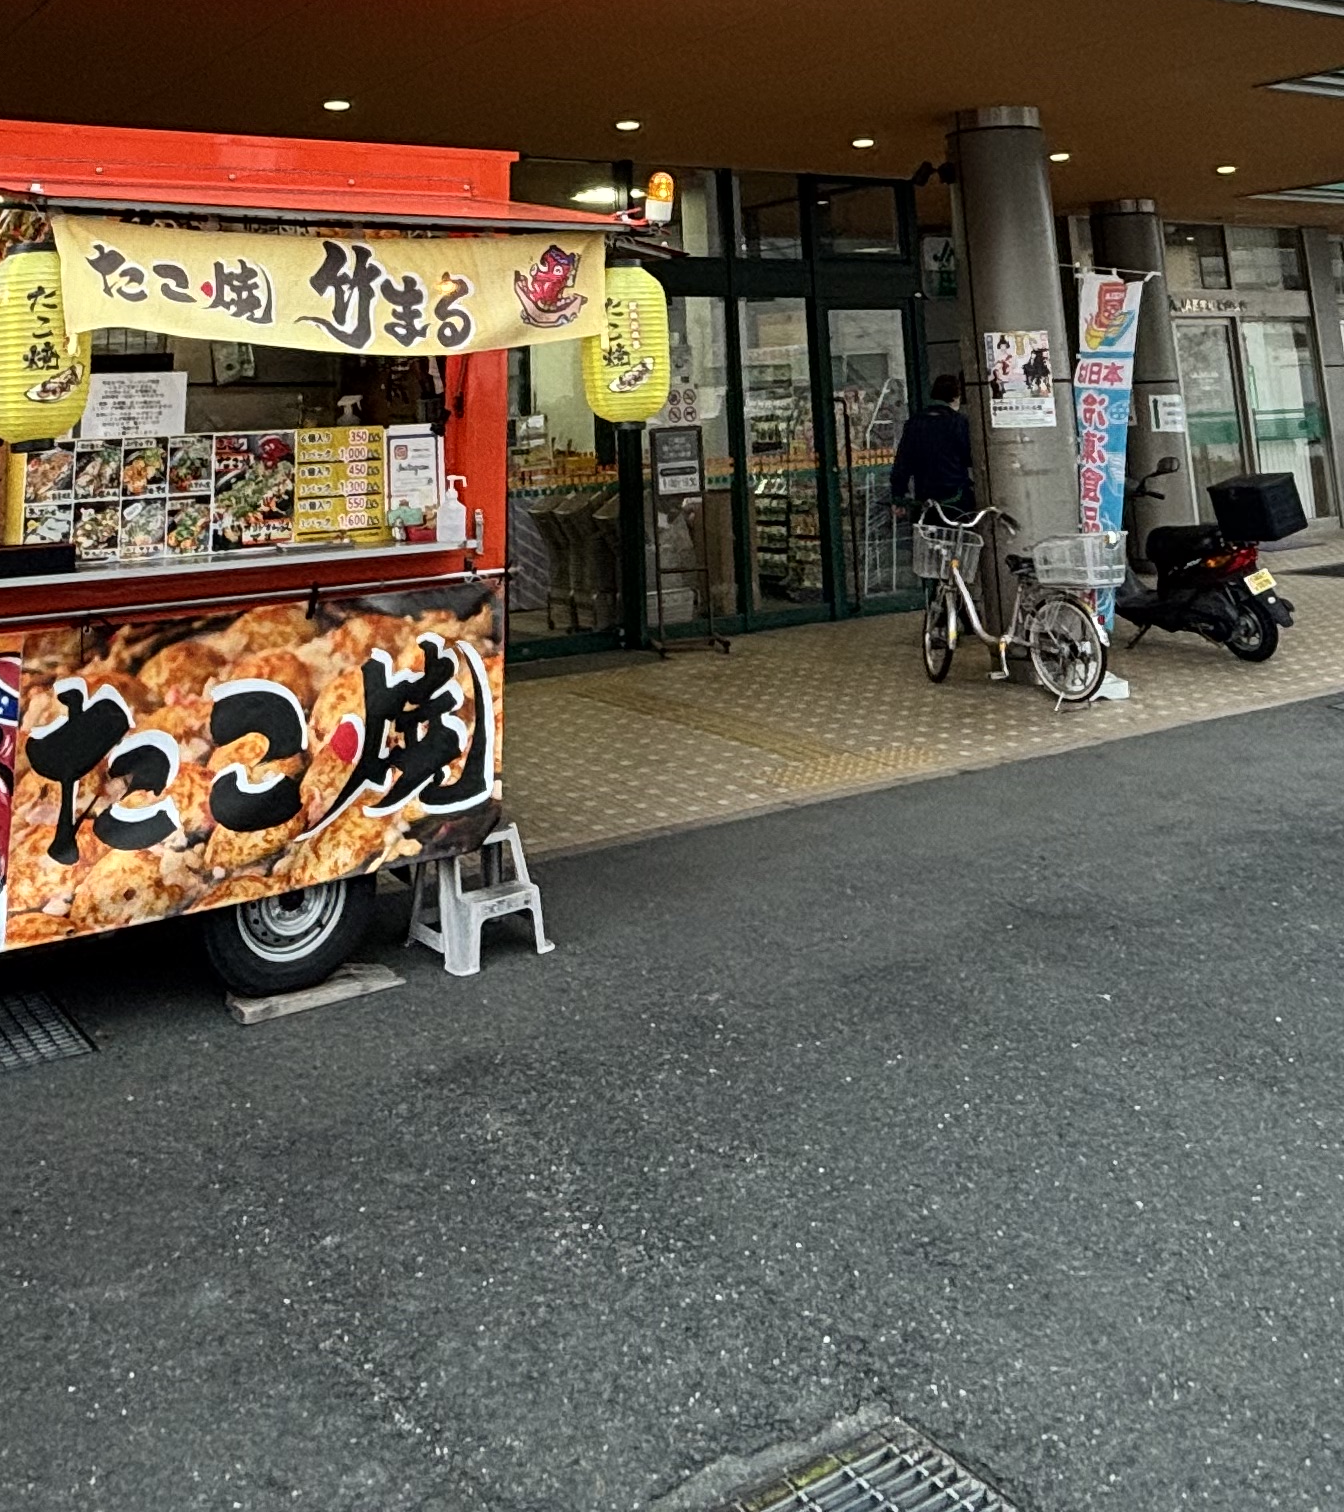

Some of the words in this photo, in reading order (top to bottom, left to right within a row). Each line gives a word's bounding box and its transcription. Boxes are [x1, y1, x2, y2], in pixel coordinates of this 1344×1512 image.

[23, 285, 61, 371] たこ焼
[86, 243, 274, 325] たこ焼
[294, 239, 478, 350] 竹まる
[348, 464, 366, 475] 450
[25, 631, 495, 865] たこ焼
